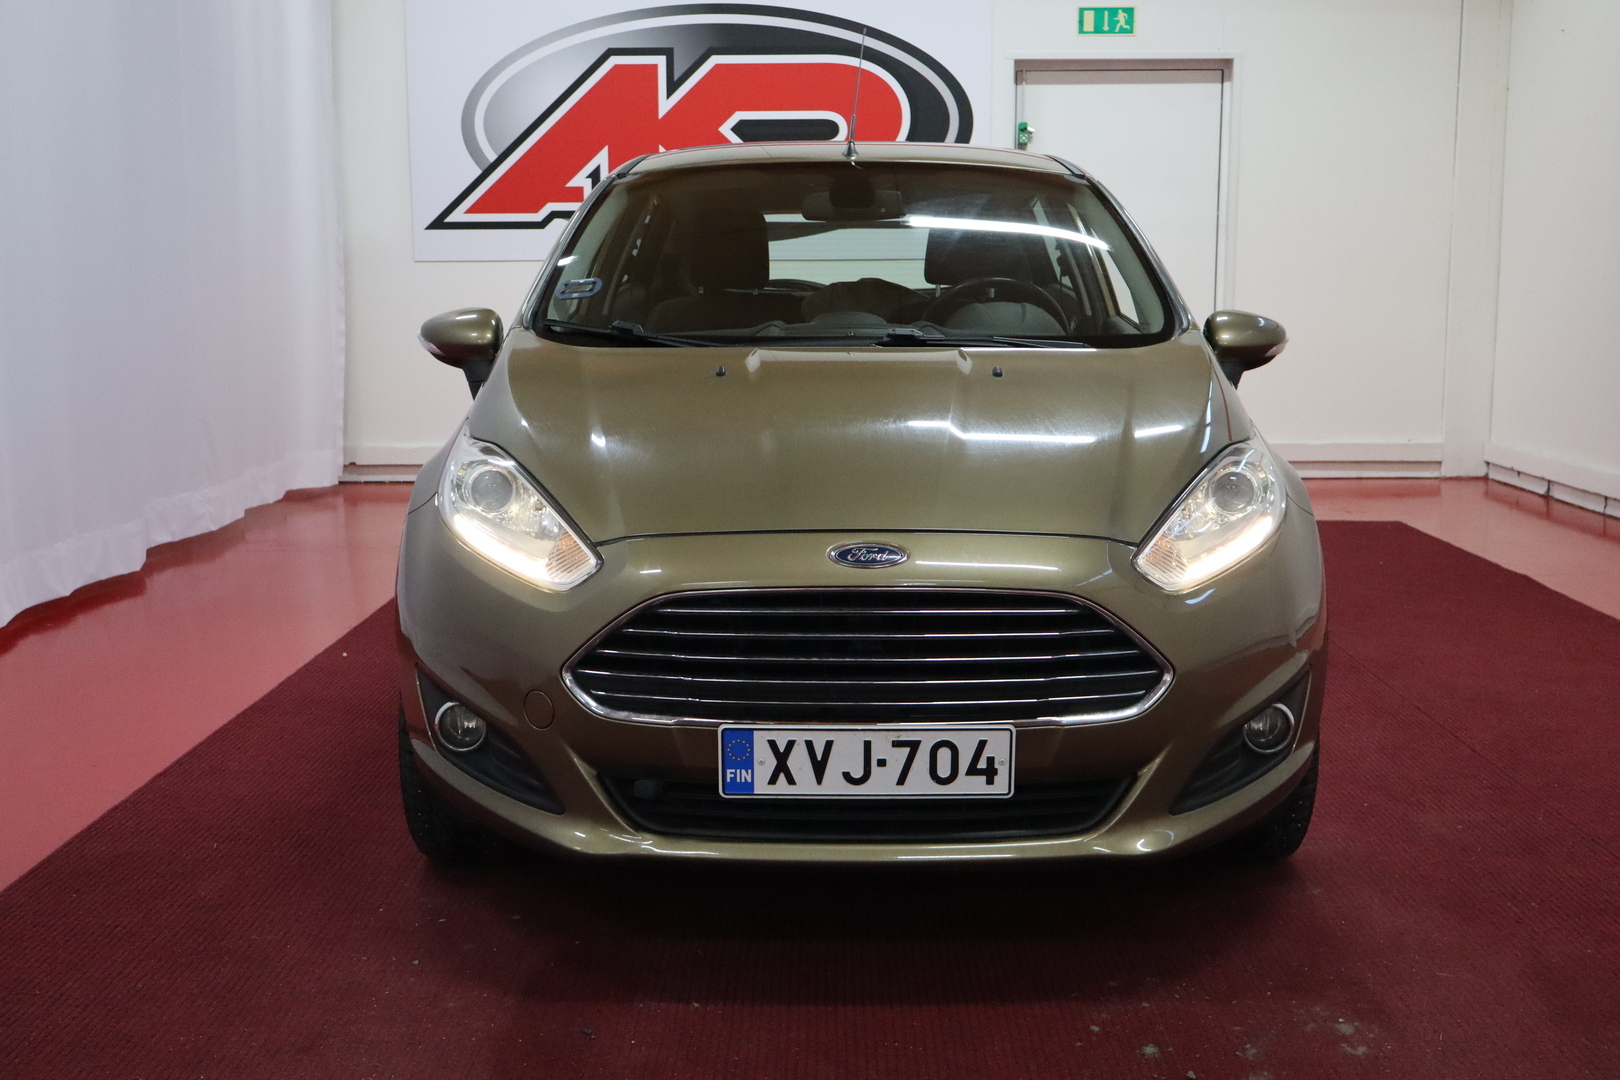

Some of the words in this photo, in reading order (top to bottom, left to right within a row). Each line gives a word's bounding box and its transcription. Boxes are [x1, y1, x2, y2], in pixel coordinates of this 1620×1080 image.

[847, 547, 889, 562] Ford
[767, 739, 998, 786] XVJ-704
[726, 769, 752, 783] FIN
